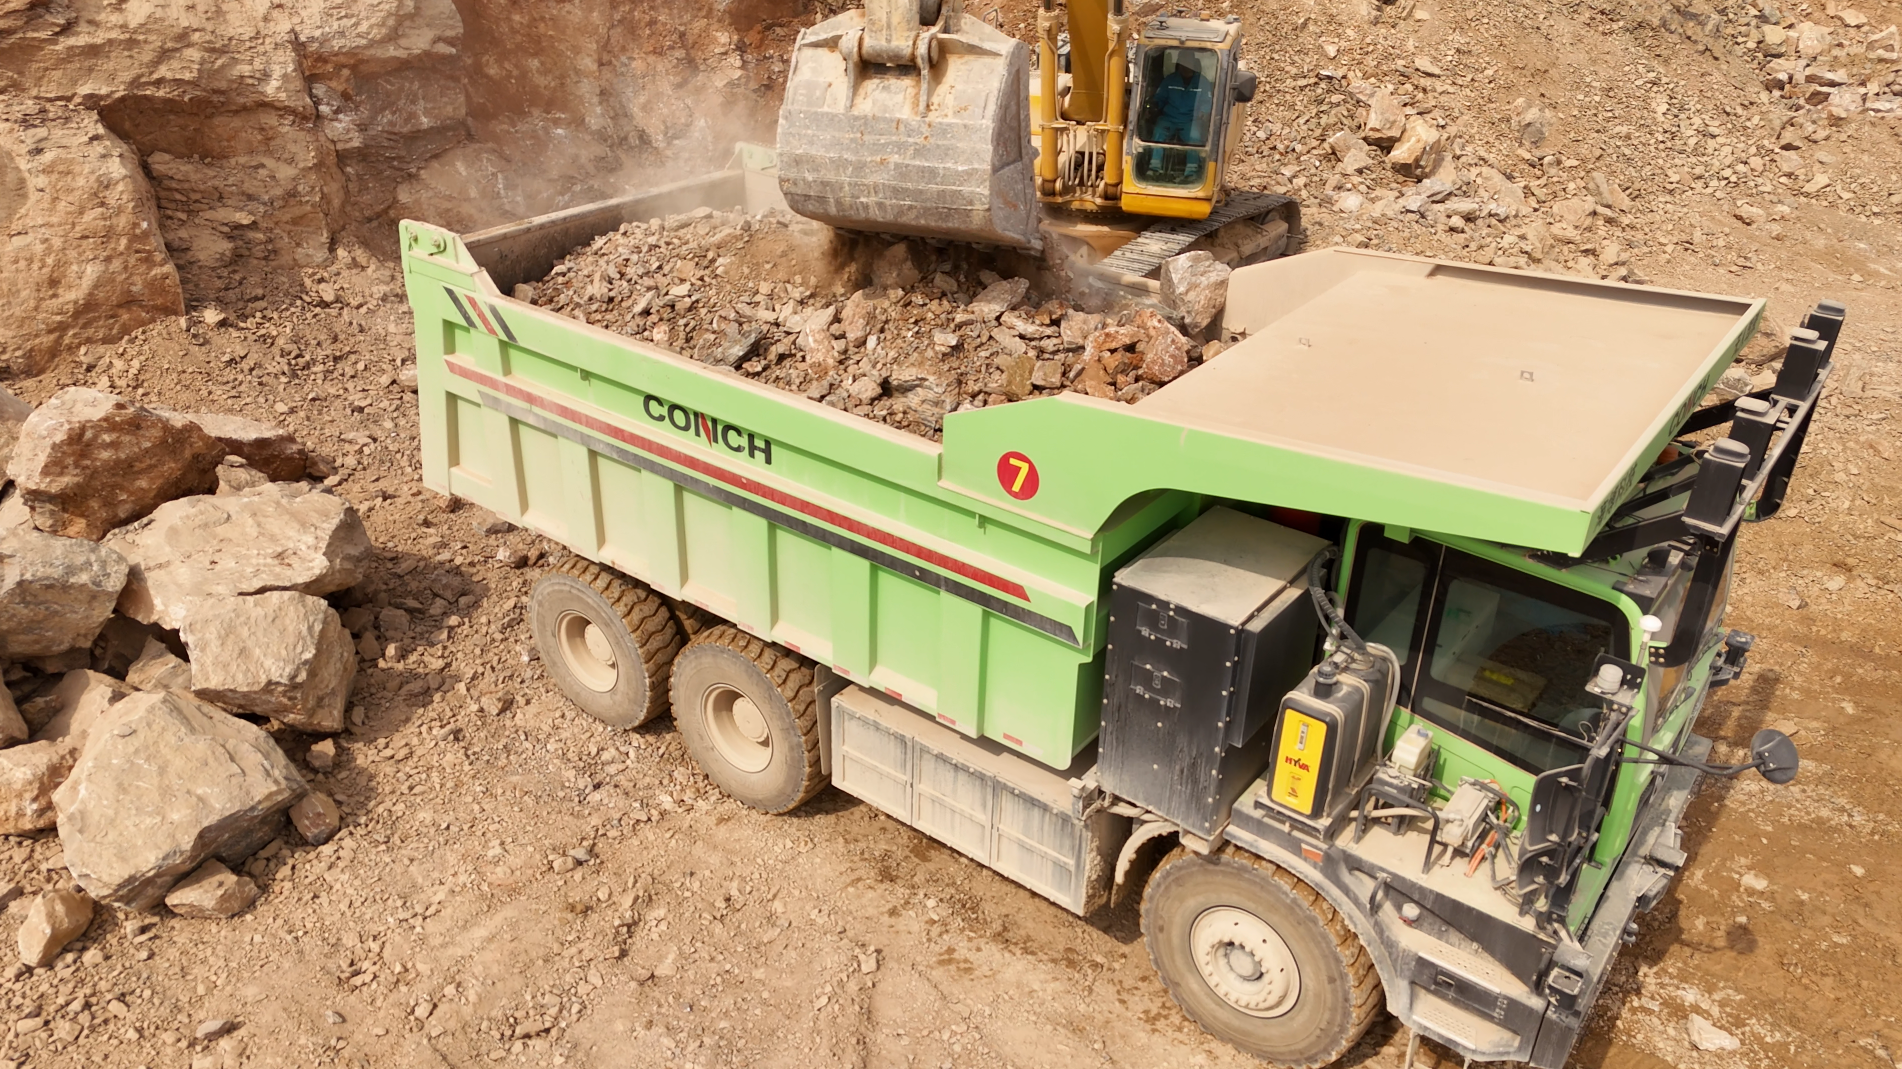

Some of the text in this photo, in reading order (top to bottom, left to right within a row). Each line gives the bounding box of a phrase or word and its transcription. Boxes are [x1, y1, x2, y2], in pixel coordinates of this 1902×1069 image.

[643, 394, 772, 465] CONCH
[1668, 374, 1710, 437] CONCH
[1009, 457, 1029, 493] 7
[1285, 756, 1310, 773] HYVA
